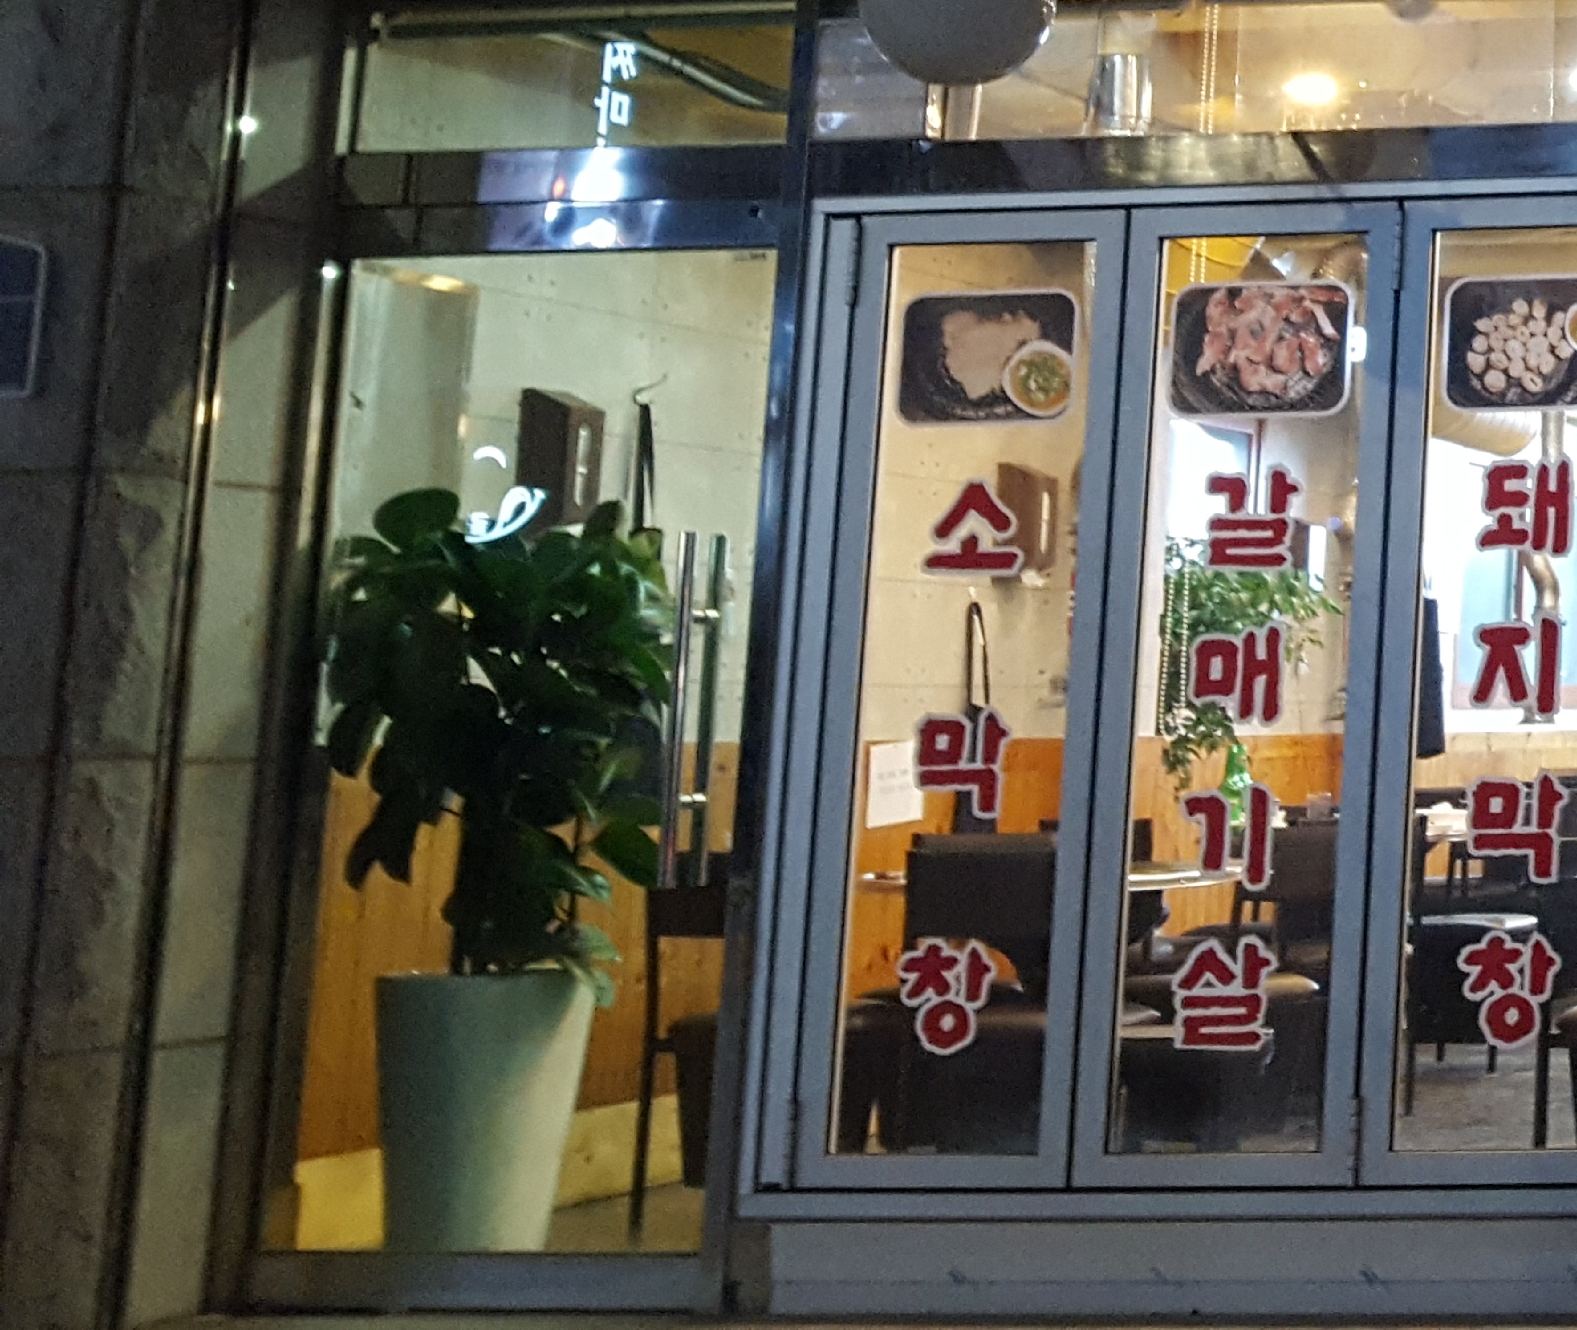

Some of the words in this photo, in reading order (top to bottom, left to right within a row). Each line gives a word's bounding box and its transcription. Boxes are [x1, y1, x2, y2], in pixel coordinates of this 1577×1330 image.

[898, 479, 1024, 1055] 소막창
[1174, 464, 1300, 1050] 갈매기살
[1457, 460, 1575, 1047] 돼지막창
